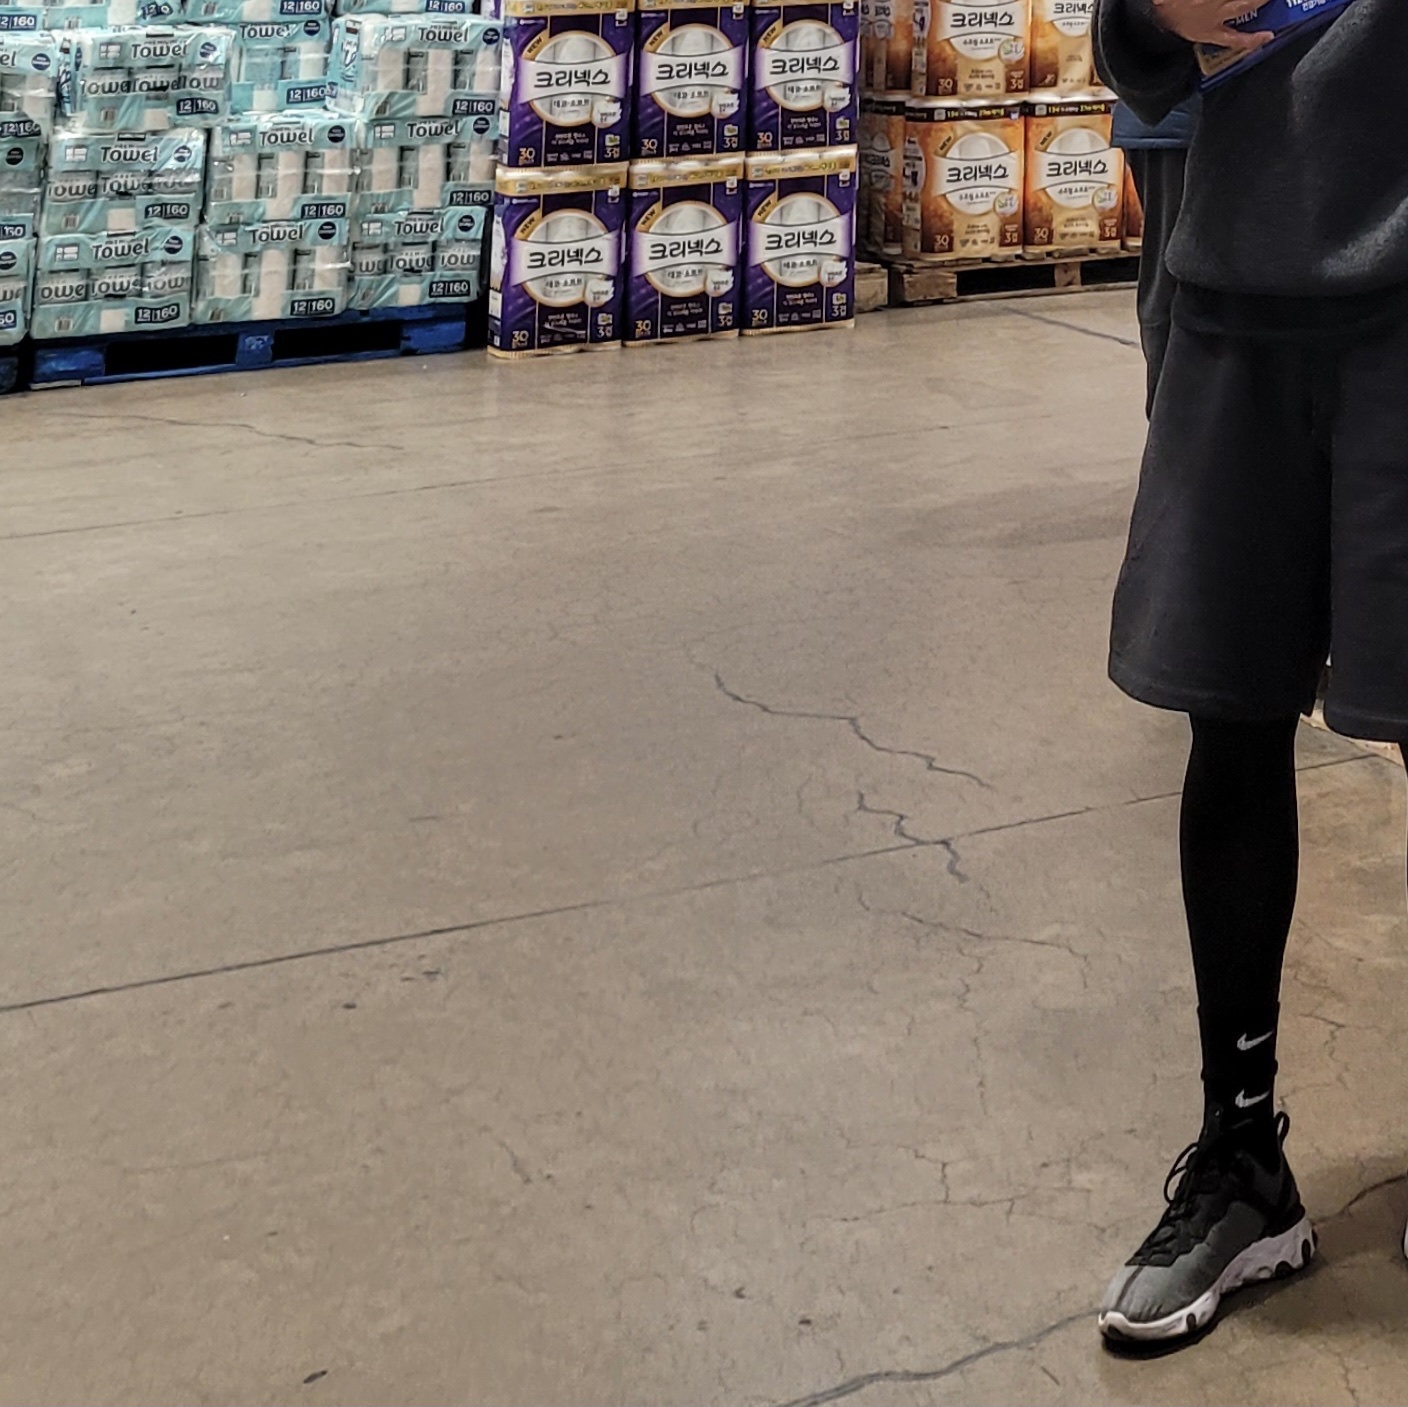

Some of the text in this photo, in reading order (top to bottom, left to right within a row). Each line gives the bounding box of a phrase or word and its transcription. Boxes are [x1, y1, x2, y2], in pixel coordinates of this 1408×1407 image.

[950, 11, 1015, 28] 크리넥스
[418, 27, 469, 42] Towel
[130, 43, 188, 59] Towel
[655, 59, 729, 80] 크리넥스
[769, 55, 840, 76] 크리넥스
[533, 67, 611, 88] 크리넥스
[258, 128, 314, 147] Towel
[407, 120, 461, 138] Towel
[100, 146, 159, 164] Towel
[518, 147, 536, 160] 30
[946, 164, 1009, 184] 크리넥스
[1046, 159, 1109, 178] 크리넥스
[649, 237, 724, 261] 크리넥스
[765, 229, 837, 251] 크리넥스
[527, 248, 604, 269] 크리넥스
